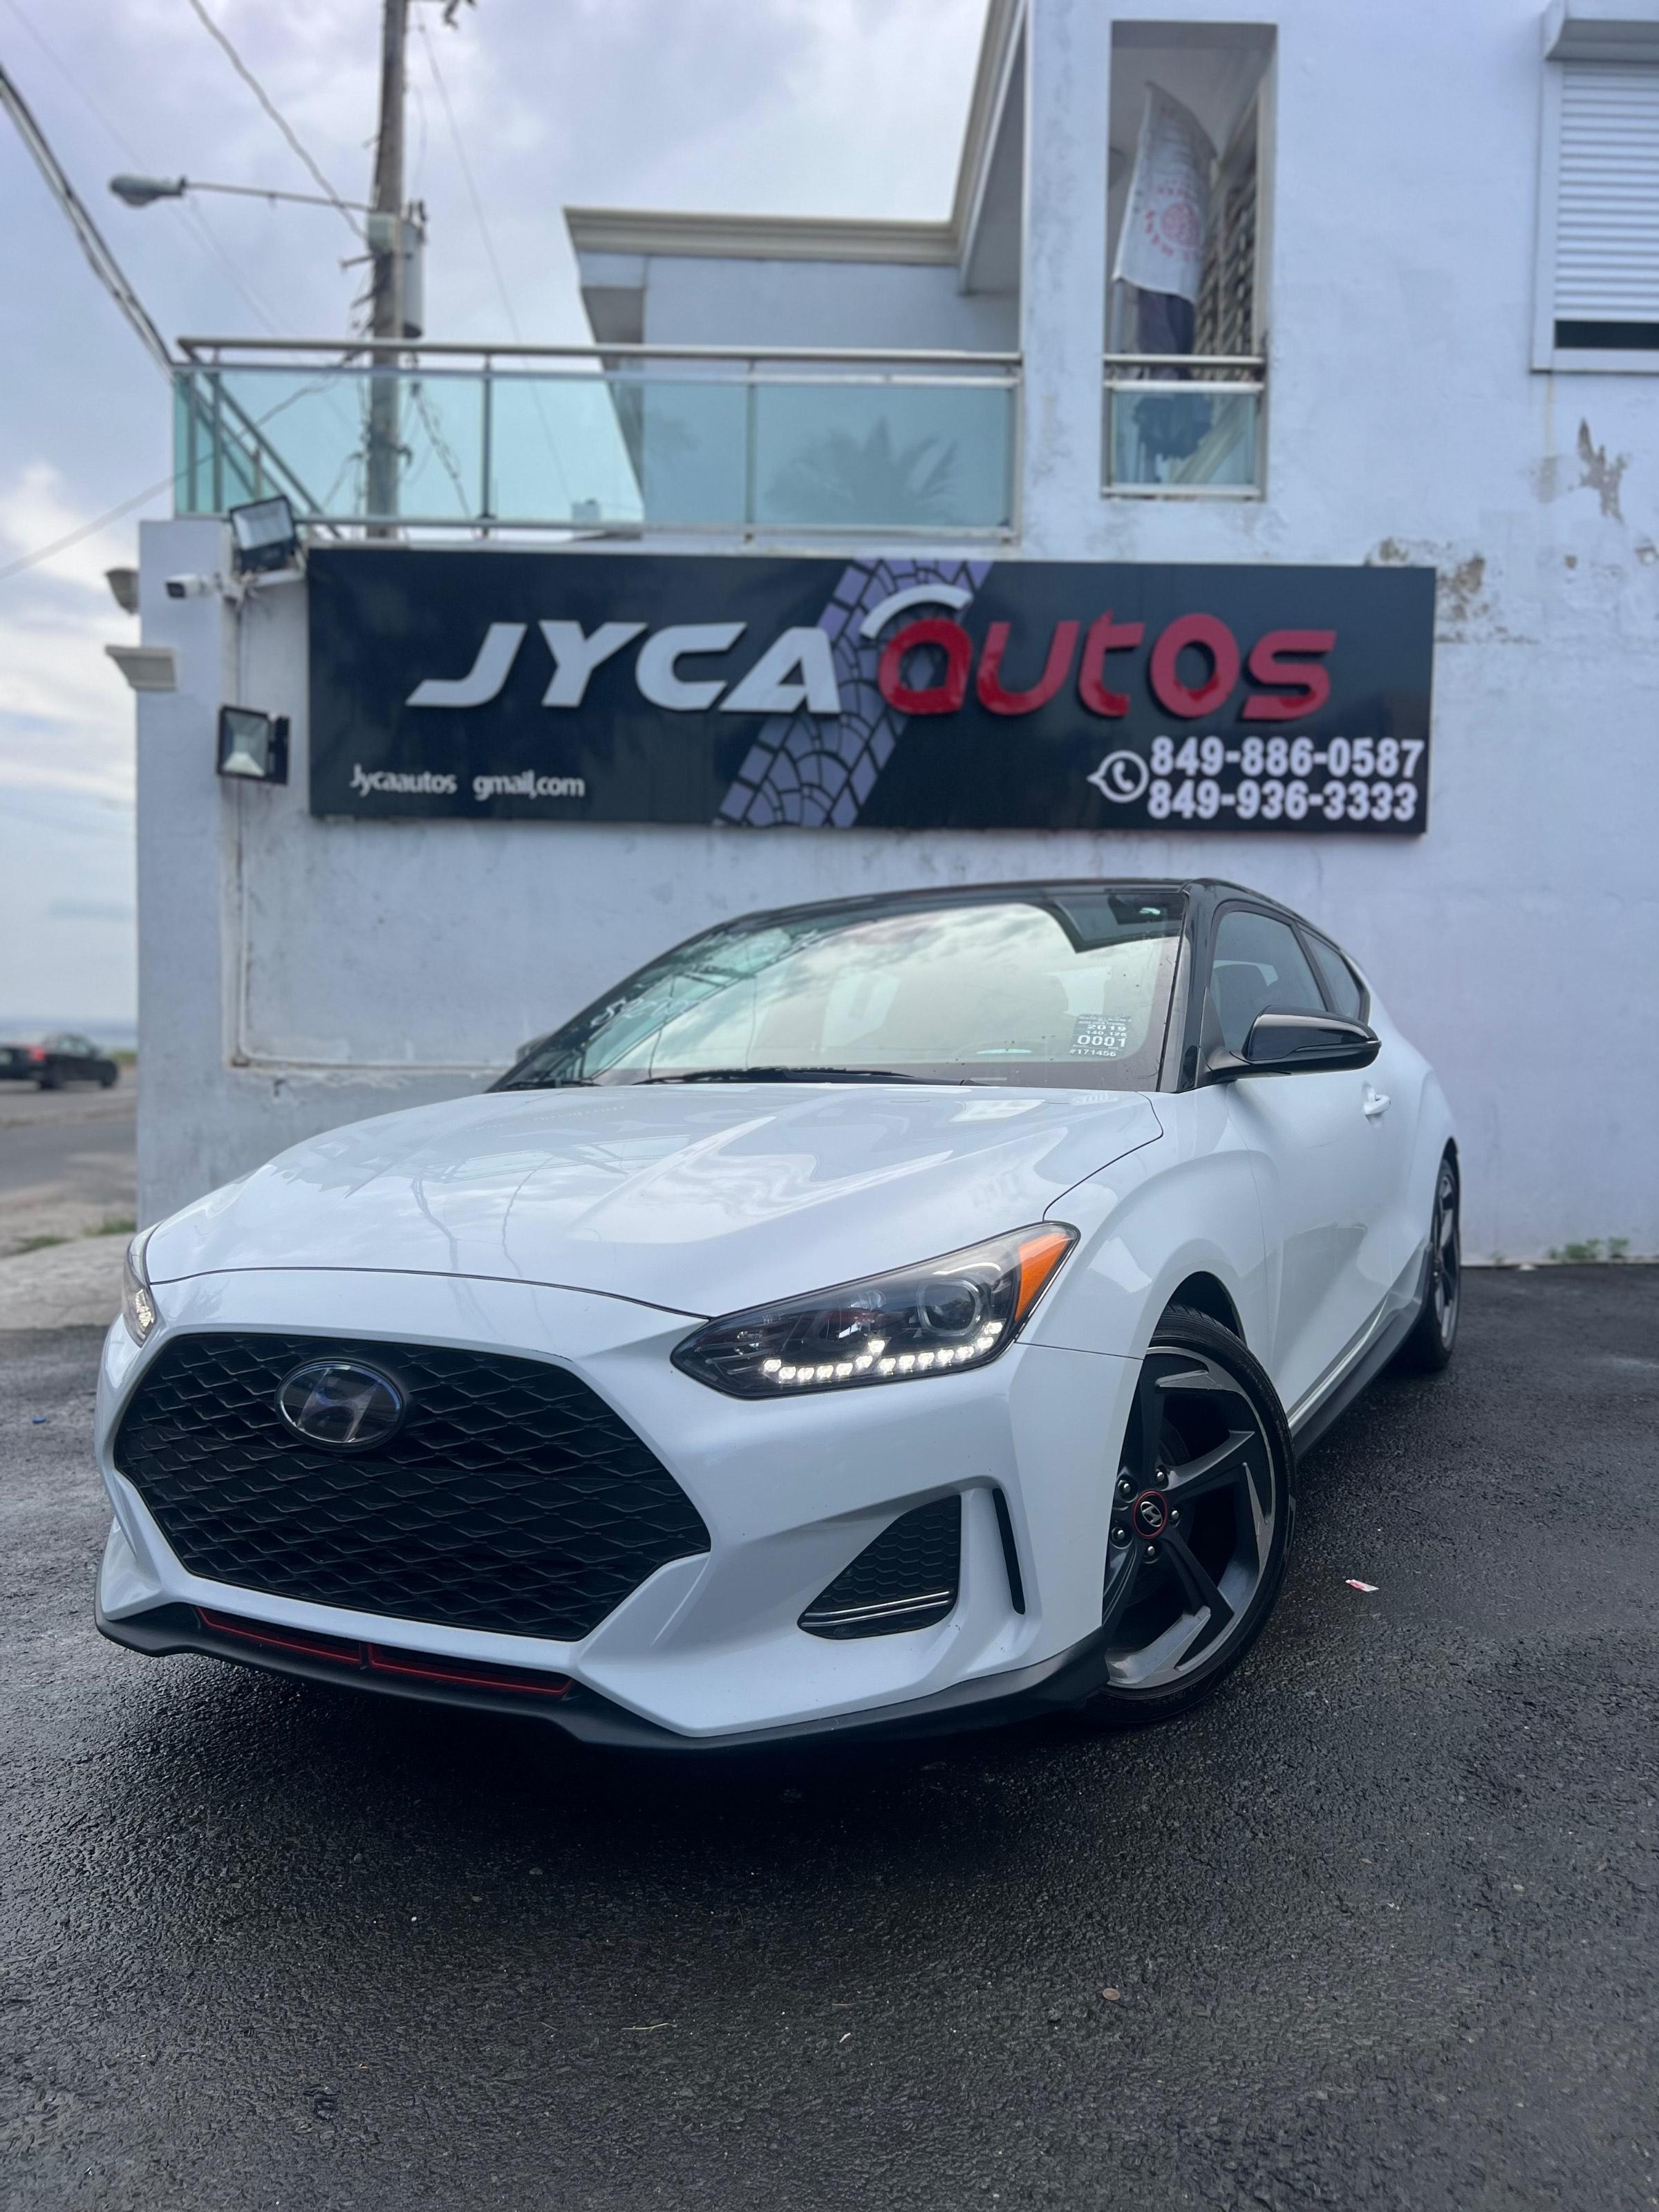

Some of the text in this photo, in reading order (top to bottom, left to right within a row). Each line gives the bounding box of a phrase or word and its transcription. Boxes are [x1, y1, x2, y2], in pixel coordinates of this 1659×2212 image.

[405, 620, 841, 713] JYCA
[1150, 736, 1425, 778] 849-886-0587
[1147, 780, 1418, 821] 849-936-3333
[1069, 1049, 1116, 1057] #171456
[1077, 1035, 1126, 1047] 0001
